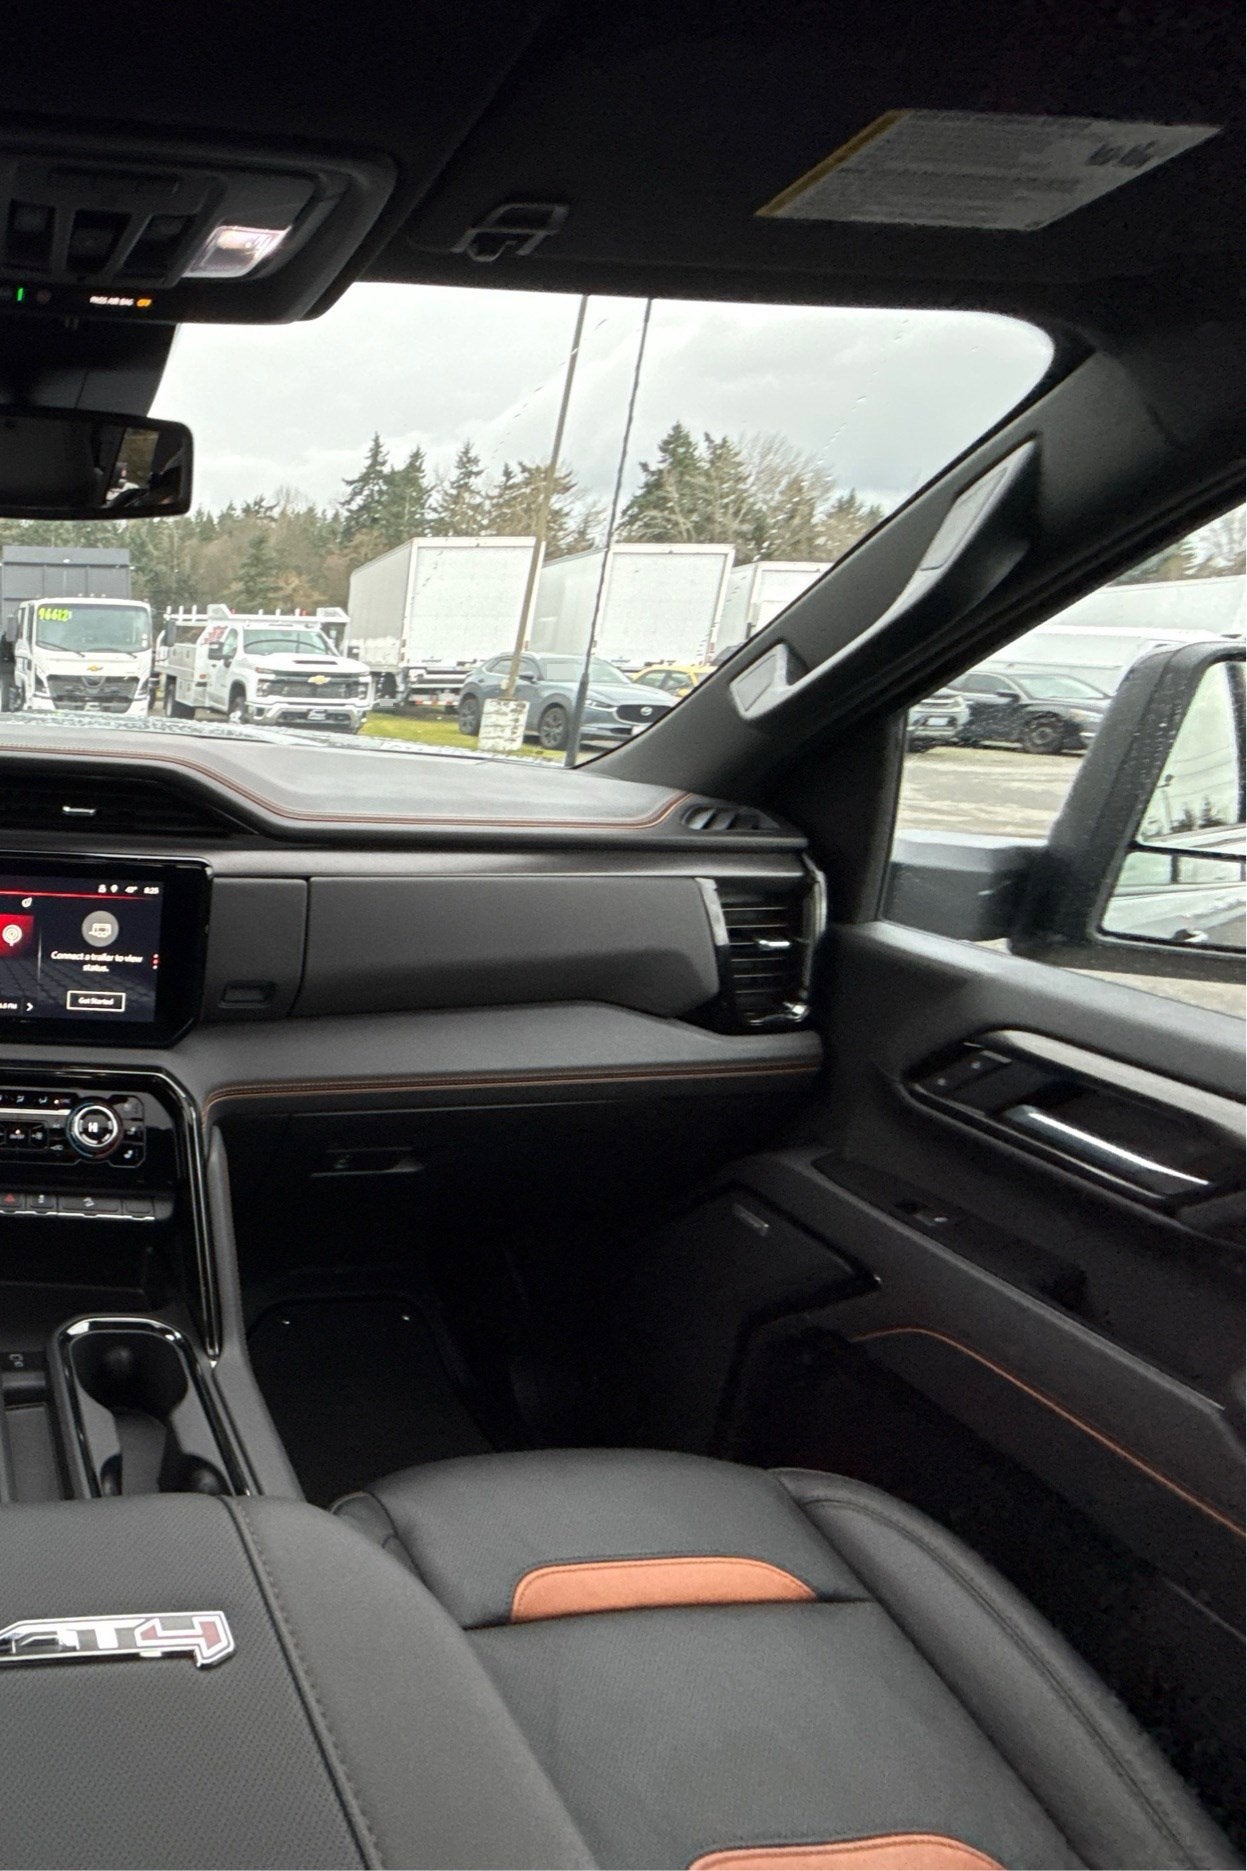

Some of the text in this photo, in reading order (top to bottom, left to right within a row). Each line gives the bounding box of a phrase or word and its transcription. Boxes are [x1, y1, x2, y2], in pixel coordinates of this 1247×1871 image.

[51, 951, 84, 960] Connect
[90, 953, 114, 961] trailer
[124, 954, 143, 963] view
